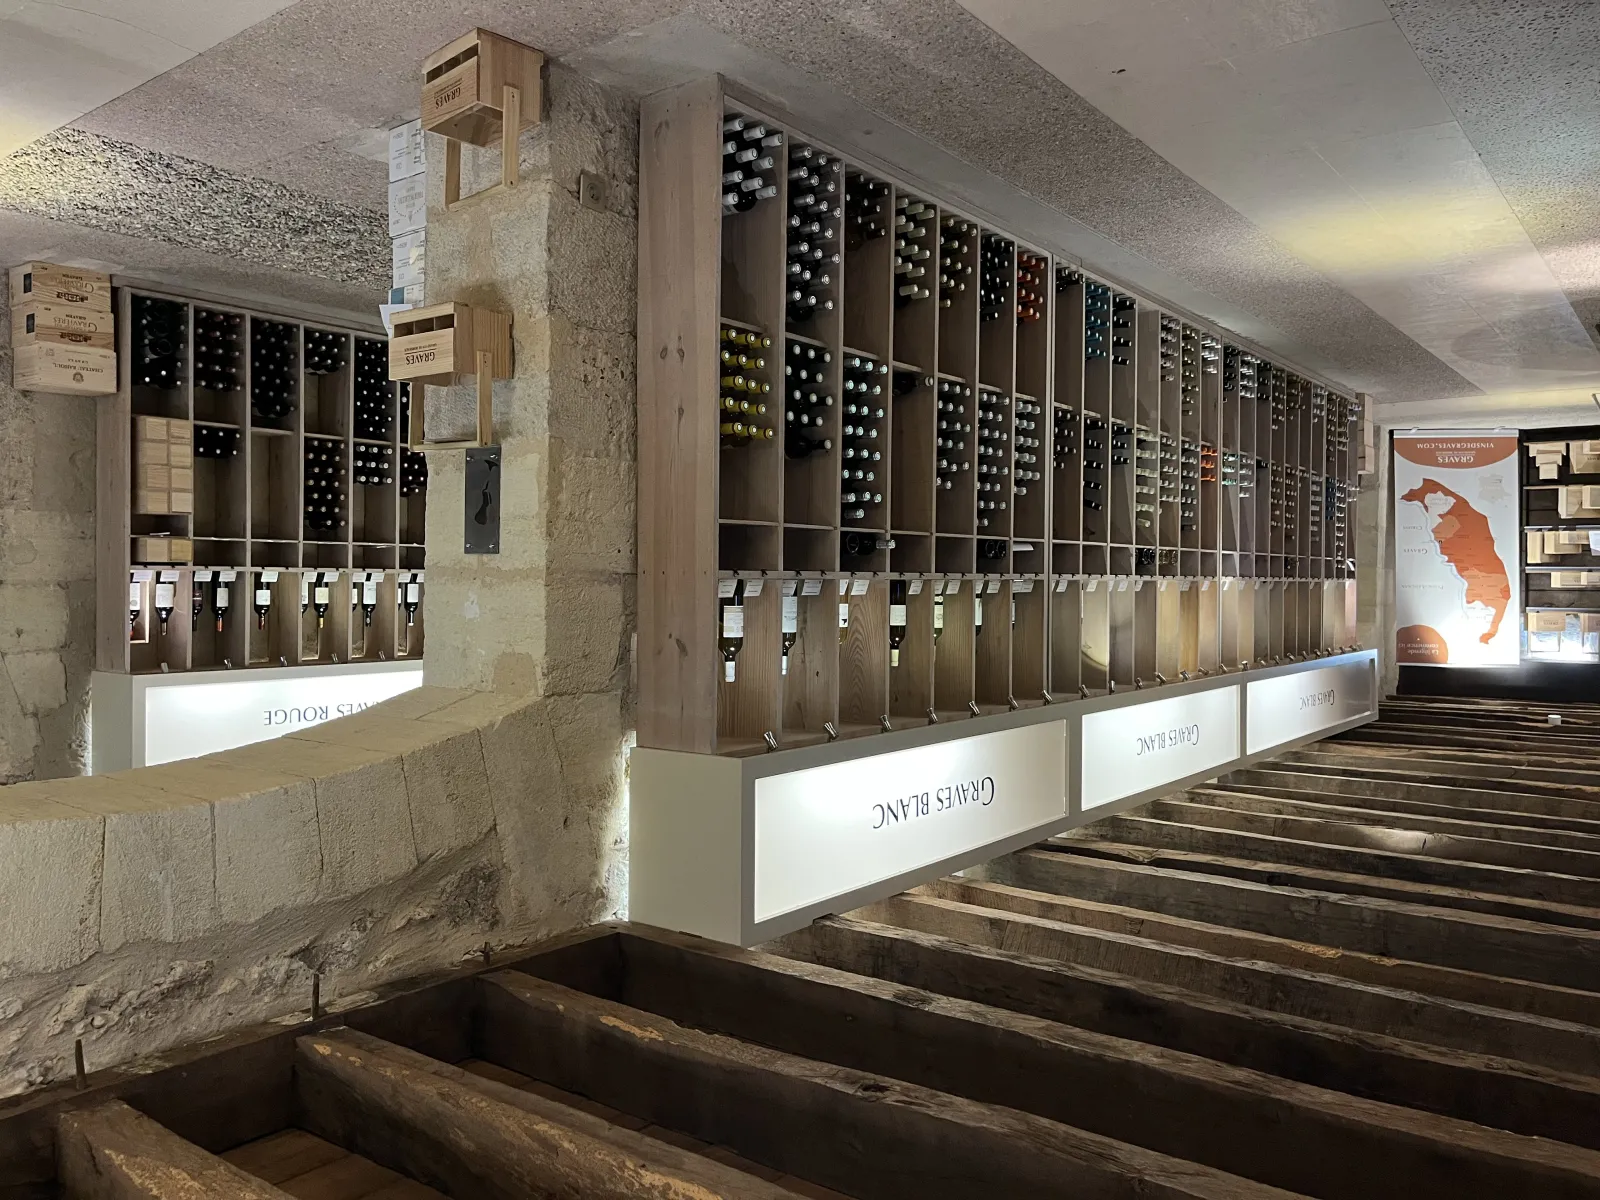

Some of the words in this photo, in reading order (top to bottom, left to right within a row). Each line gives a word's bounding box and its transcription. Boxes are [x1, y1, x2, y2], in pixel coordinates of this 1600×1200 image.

[435, 86, 461, 109] GRAVES
[405, 351, 435, 365] GRAVES
[1416, 442, 1494, 450] VINSDEGRAVES.COM
[1437, 456, 1474, 464] GRAVES
[1299, 694, 1317, 710] BLANC
[1317, 689, 1335, 706] GRAVES
[263, 705, 328, 726] ROUGE
[1136, 731, 1166, 756] BLANC
[1168, 724, 1200, 746] GRAVES
[936, 777, 995, 812] GRAVES
[872, 792, 929, 829] BLANC
